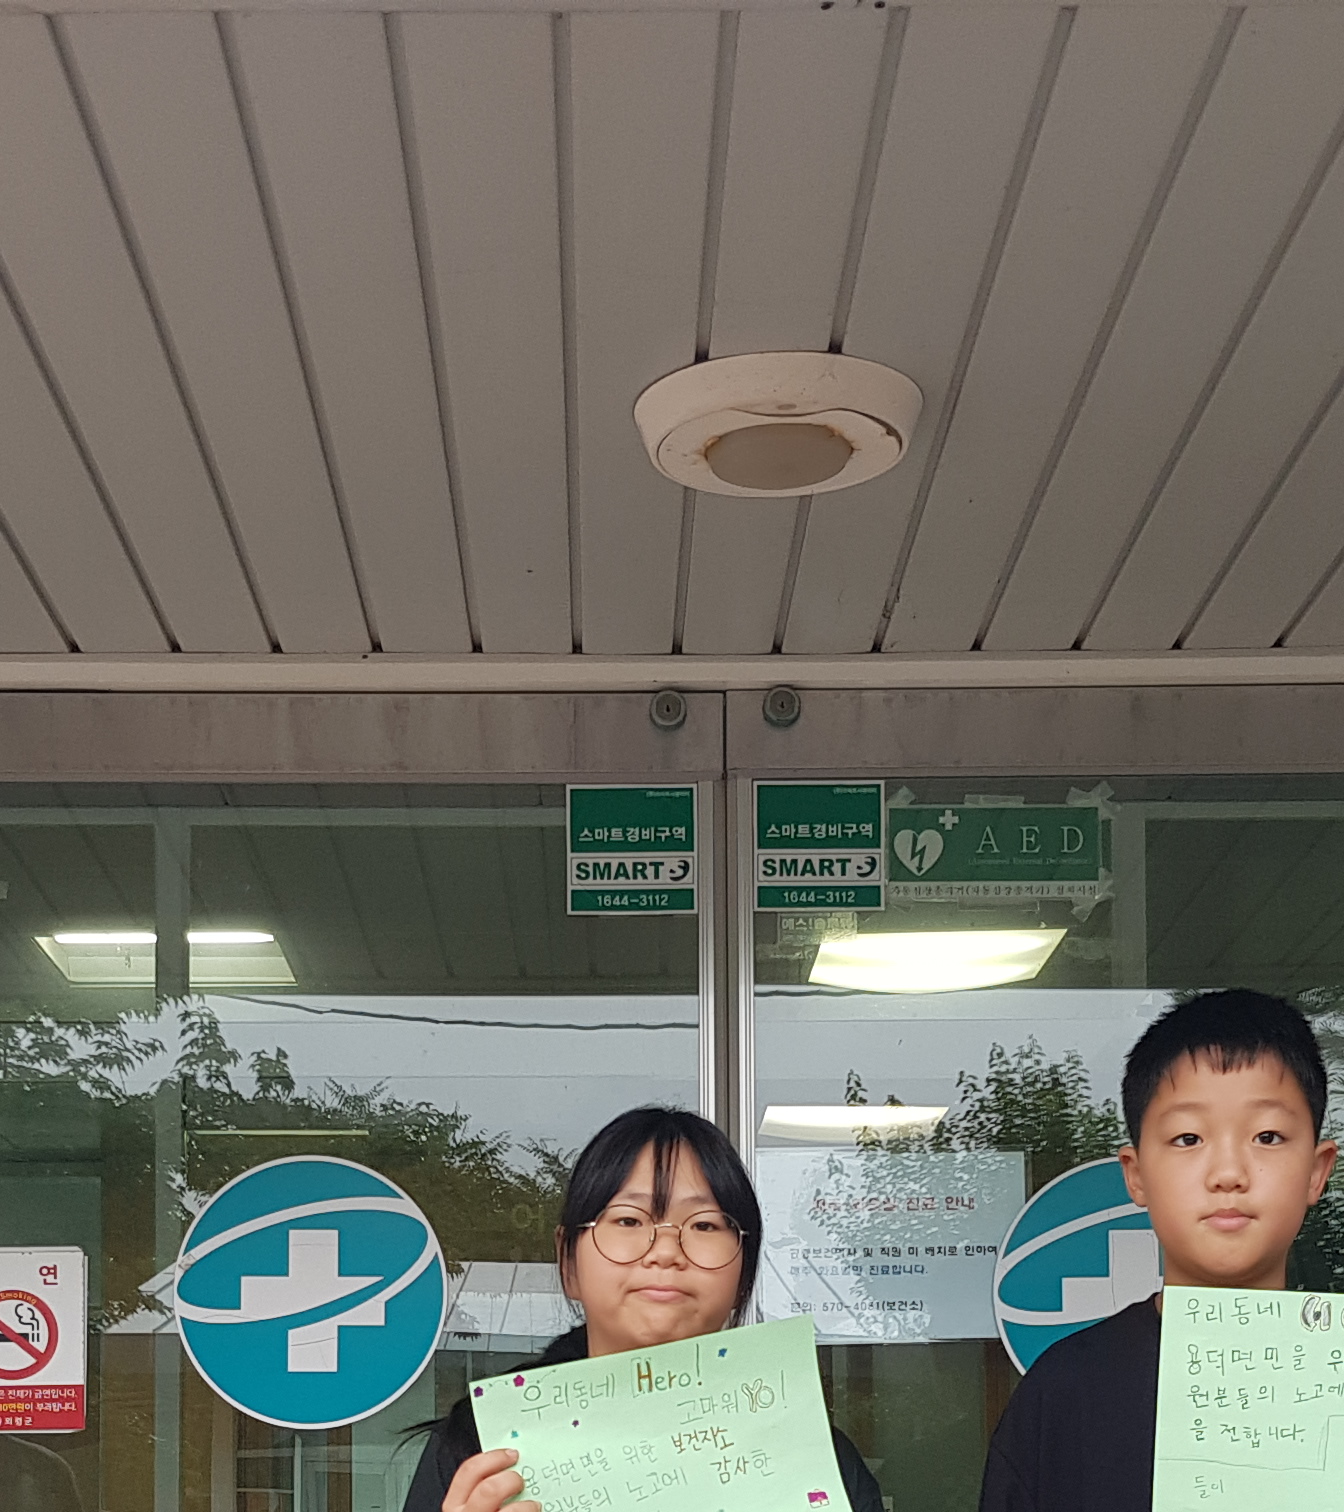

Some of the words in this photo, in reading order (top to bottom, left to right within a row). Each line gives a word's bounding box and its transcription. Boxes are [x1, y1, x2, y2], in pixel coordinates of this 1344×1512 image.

[578, 826, 686, 842] 스마트경비구역
[765, 823, 873, 839] 스마트경비구역
[575, 861, 665, 881] SMART
[762, 858, 852, 877] SMART
[597, 894, 669, 907] 1644-3112
[783, 891, 856, 903] 1644-3112
[1184, 1296, 1282, 1326] 우리동네
[521, 1373, 616, 1421] 우리동네
[630, 1343, 703, 1398] Hero!
[7, 1389, 33, 1400] 전체가
[34, 1388, 78, 1400] 금연입니다.
[1187, 1384, 1276, 1410] 원분들의
[622, 1440, 659, 1465] 위한
[625, 1467, 688, 1503] 노고에
[709, 1449, 775, 1484] 감사한
